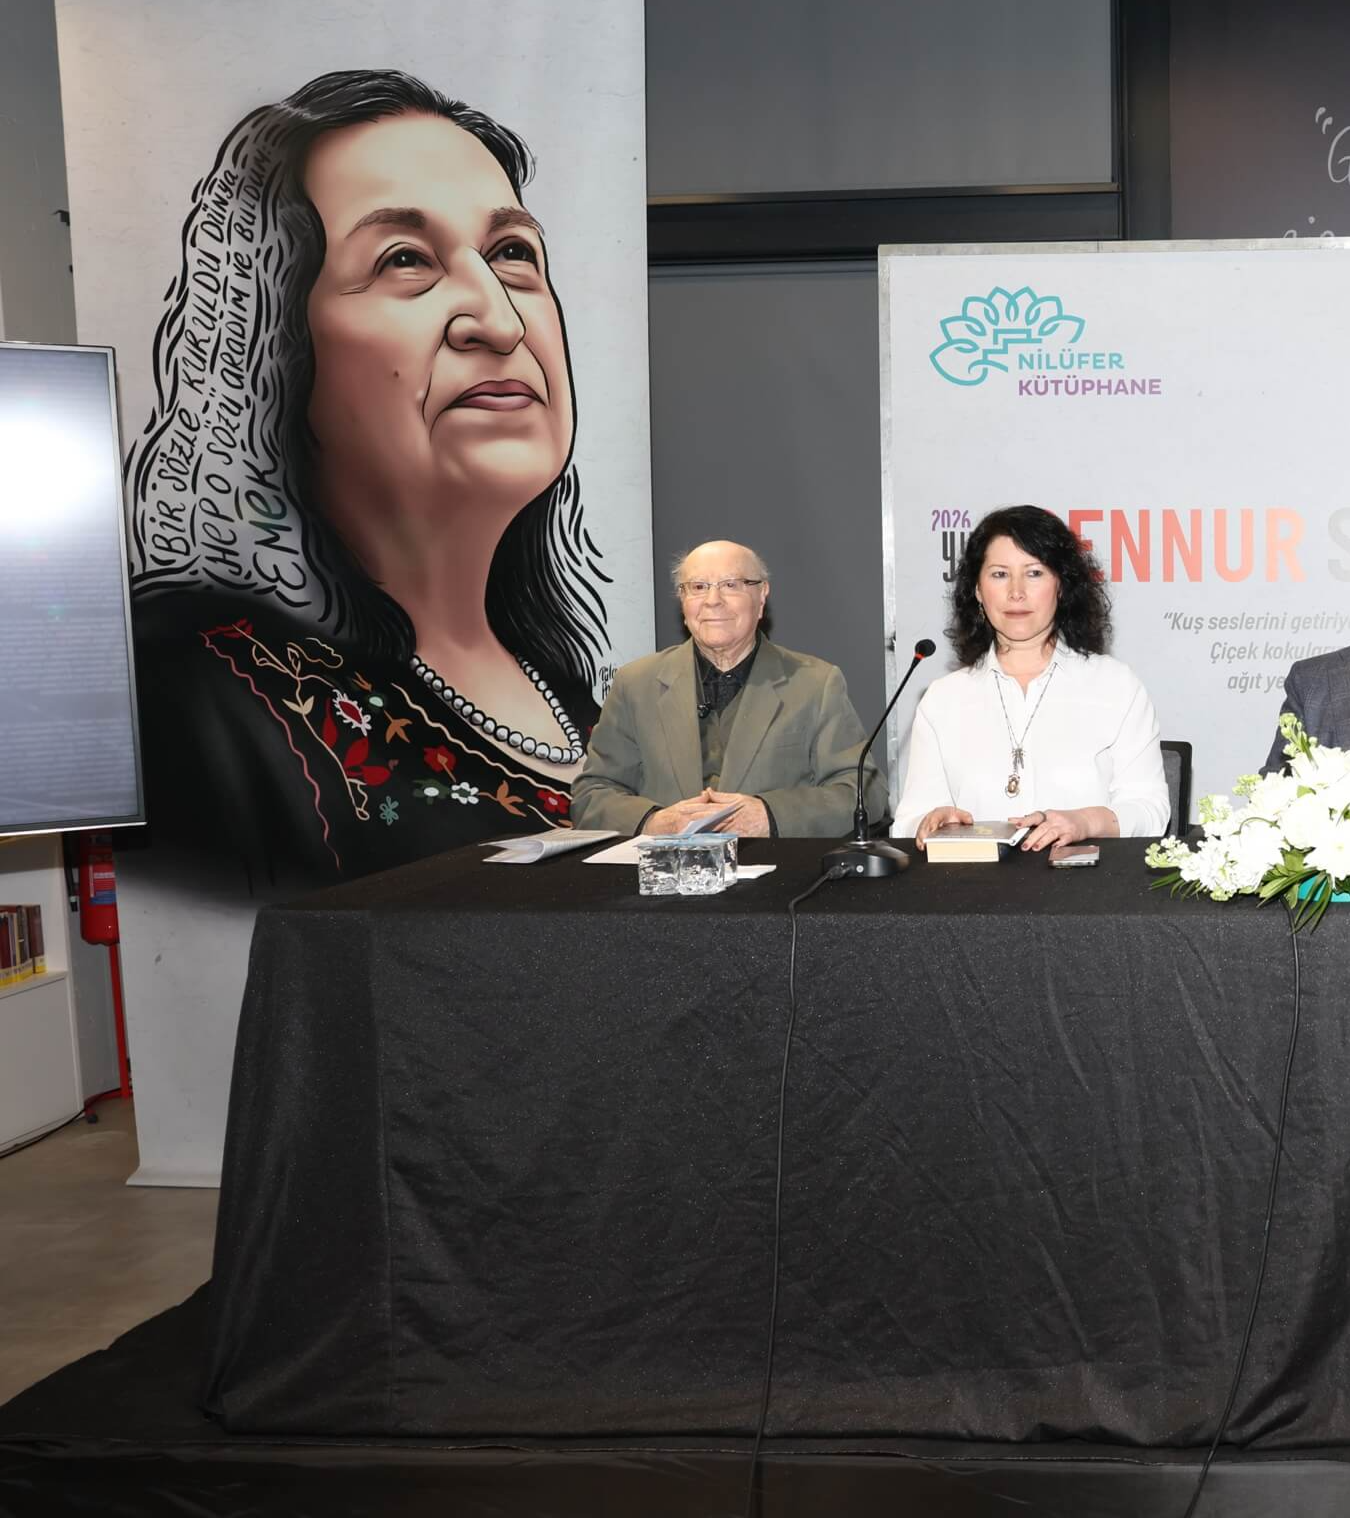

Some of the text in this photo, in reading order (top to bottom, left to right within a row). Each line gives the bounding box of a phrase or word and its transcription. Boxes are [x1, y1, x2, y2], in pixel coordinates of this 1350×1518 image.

[1018, 348, 1125, 370] NİLÜFER
[1018, 375, 1162, 396] KÜTÜPHANE
[205, 473, 232, 494] O
[931, 509, 971, 531] 2026
[1046, 507, 1304, 583] ENNUR
[1208, 611, 1286, 631] seslerini
[1210, 641, 1258, 664] Çiçek
[1227, 671, 1261, 694] ağıt
